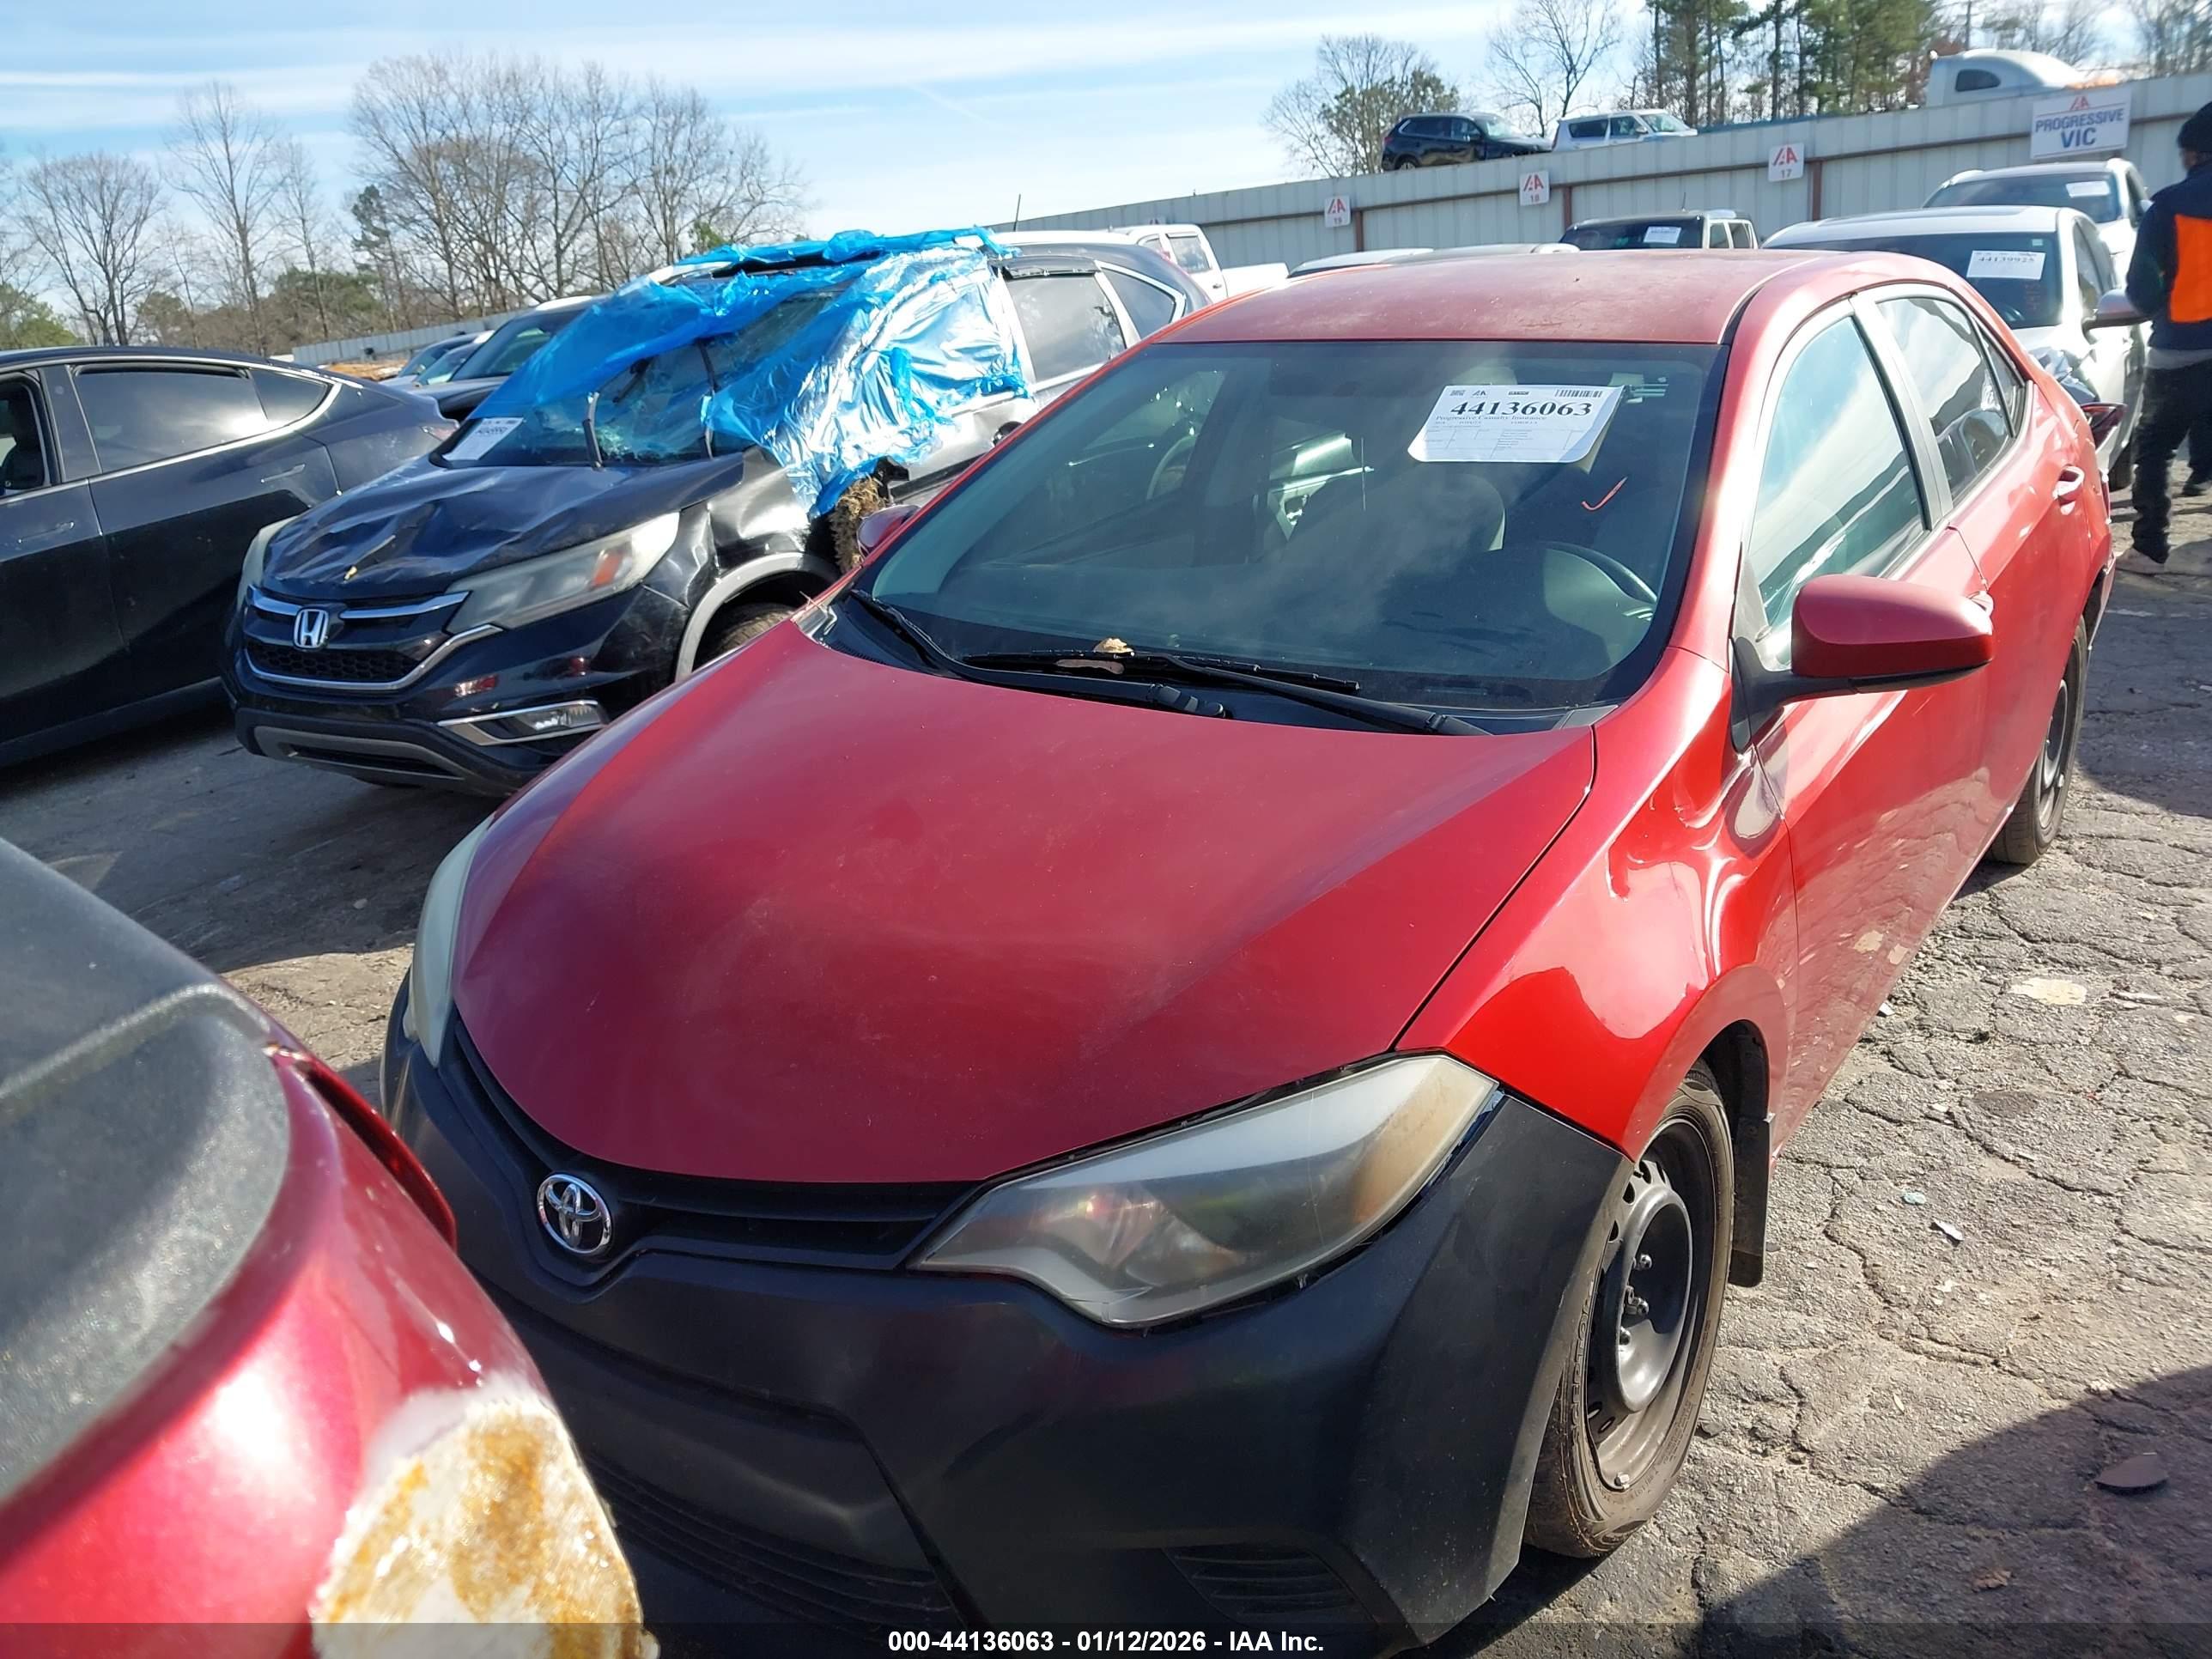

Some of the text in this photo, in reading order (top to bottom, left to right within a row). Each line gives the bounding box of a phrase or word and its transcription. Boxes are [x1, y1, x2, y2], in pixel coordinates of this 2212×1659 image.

[2035, 108, 2125, 132] PROGRESSIVE
[2062, 127, 2097, 149] VIC
[1781, 168, 1792, 179] 17
[1450, 401, 1592, 416] 44136063
